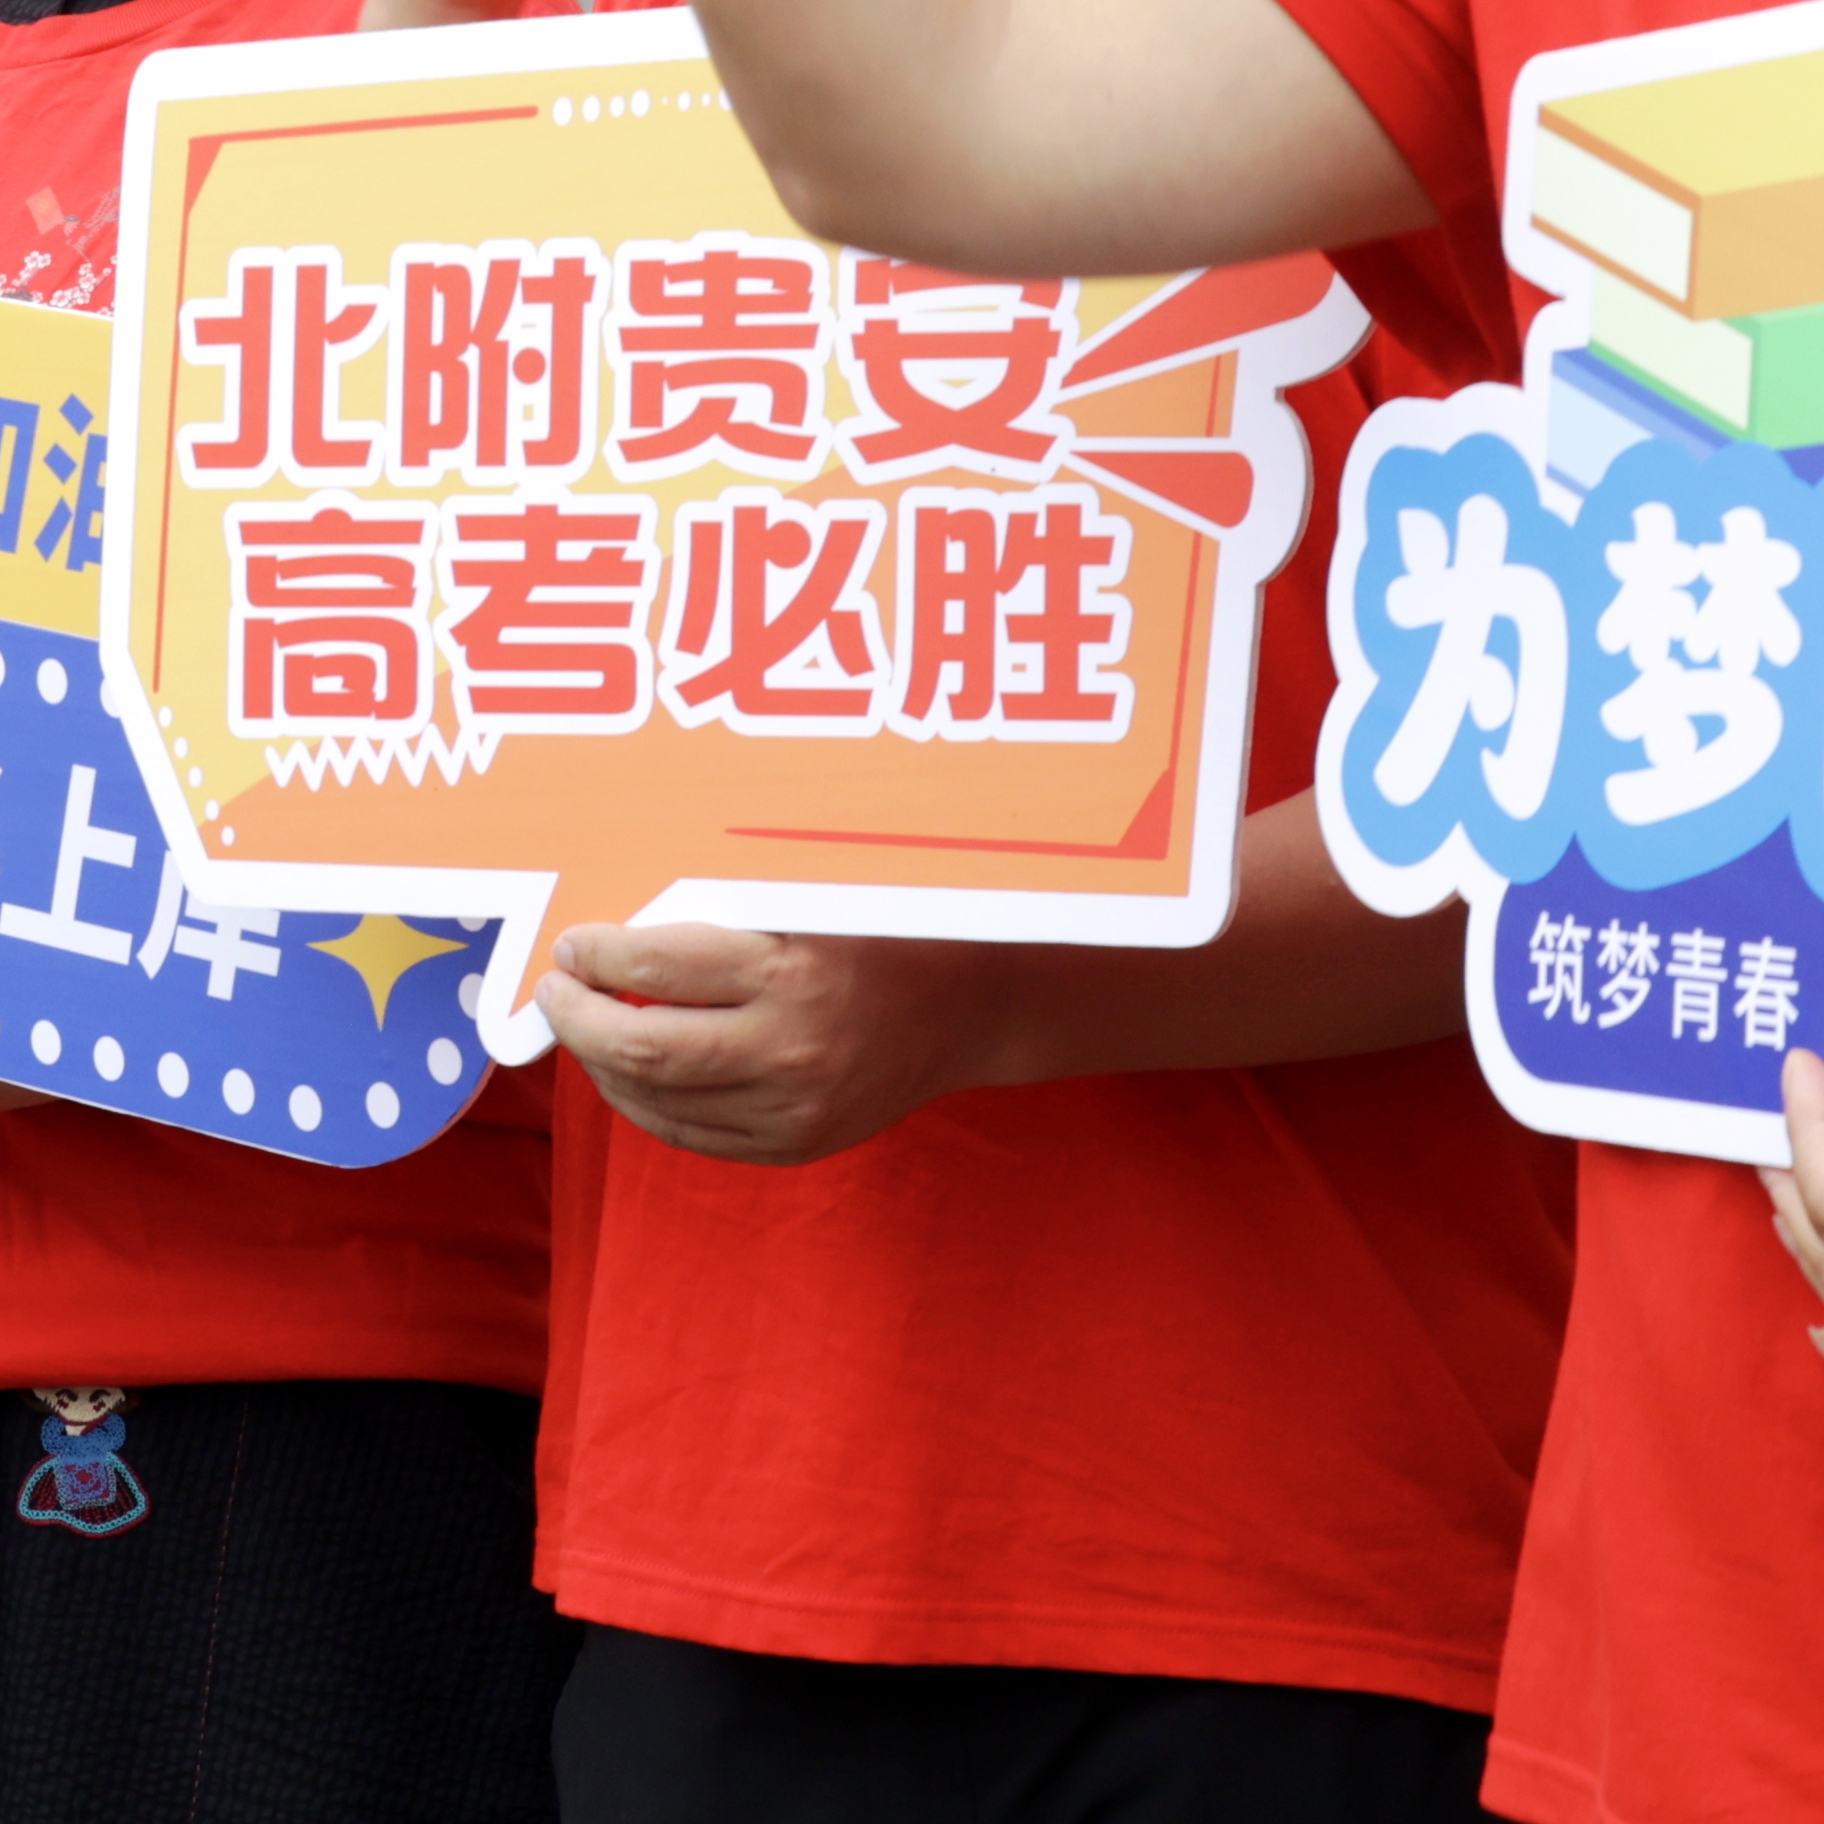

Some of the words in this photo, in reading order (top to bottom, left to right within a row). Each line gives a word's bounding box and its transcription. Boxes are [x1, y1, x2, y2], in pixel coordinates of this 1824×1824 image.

[191, 252, 1063, 469] 北附贵安
[239, 504, 1117, 722] 高考必胜
[1374, 493, 1801, 826] 为梦
[1526, 909, 1801, 1053] 筑梦青春
